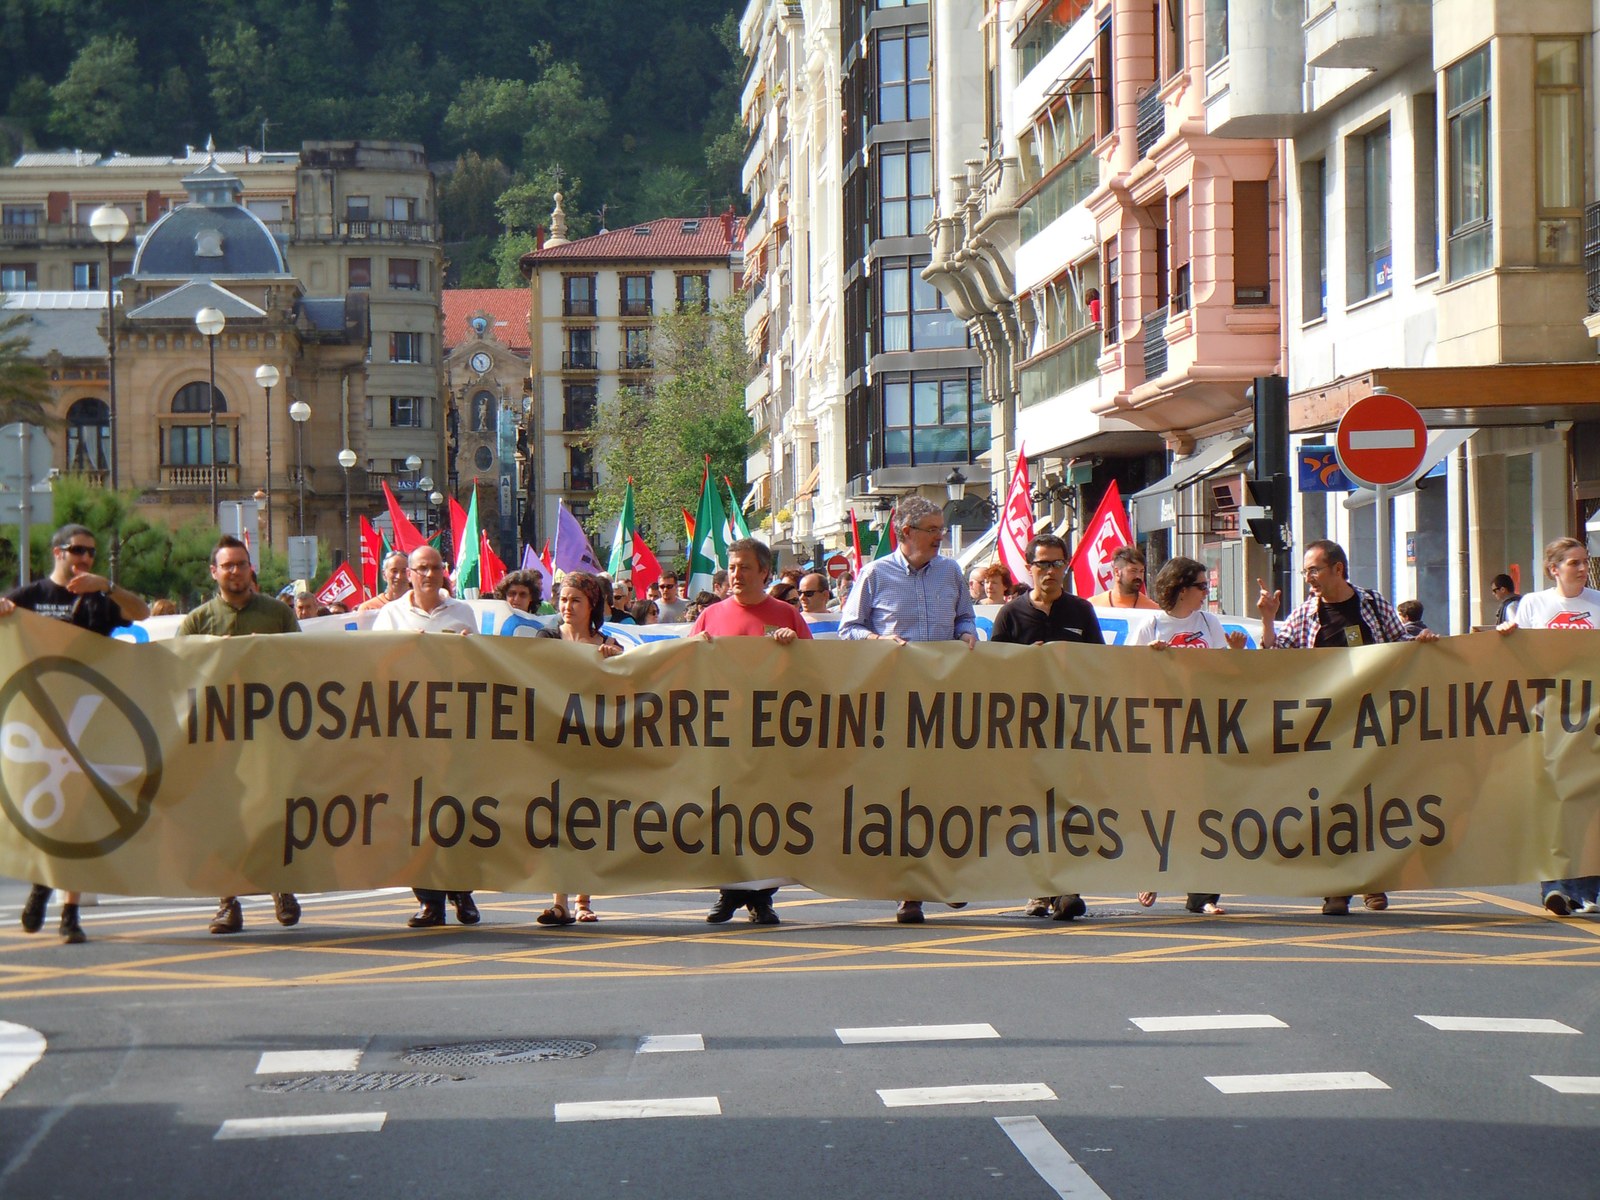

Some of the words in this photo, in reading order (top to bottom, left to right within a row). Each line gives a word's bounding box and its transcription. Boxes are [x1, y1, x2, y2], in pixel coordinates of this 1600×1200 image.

[187, 681, 535, 744] INPOSAKETEI
[557, 690, 729, 748] AURRE
[752, 690, 885, 748] EGIN!
[907, 692, 1249, 755] MURRIZKETAK
[1273, 698, 1332, 754] EZ
[284, 793, 388, 866] por
[412, 776, 500, 848] los
[526, 779, 813, 856] derechos
[843, 785, 1123, 860] laborales
[1141, 810, 1175, 872] y
[1199, 783, 1446, 861] sociales
